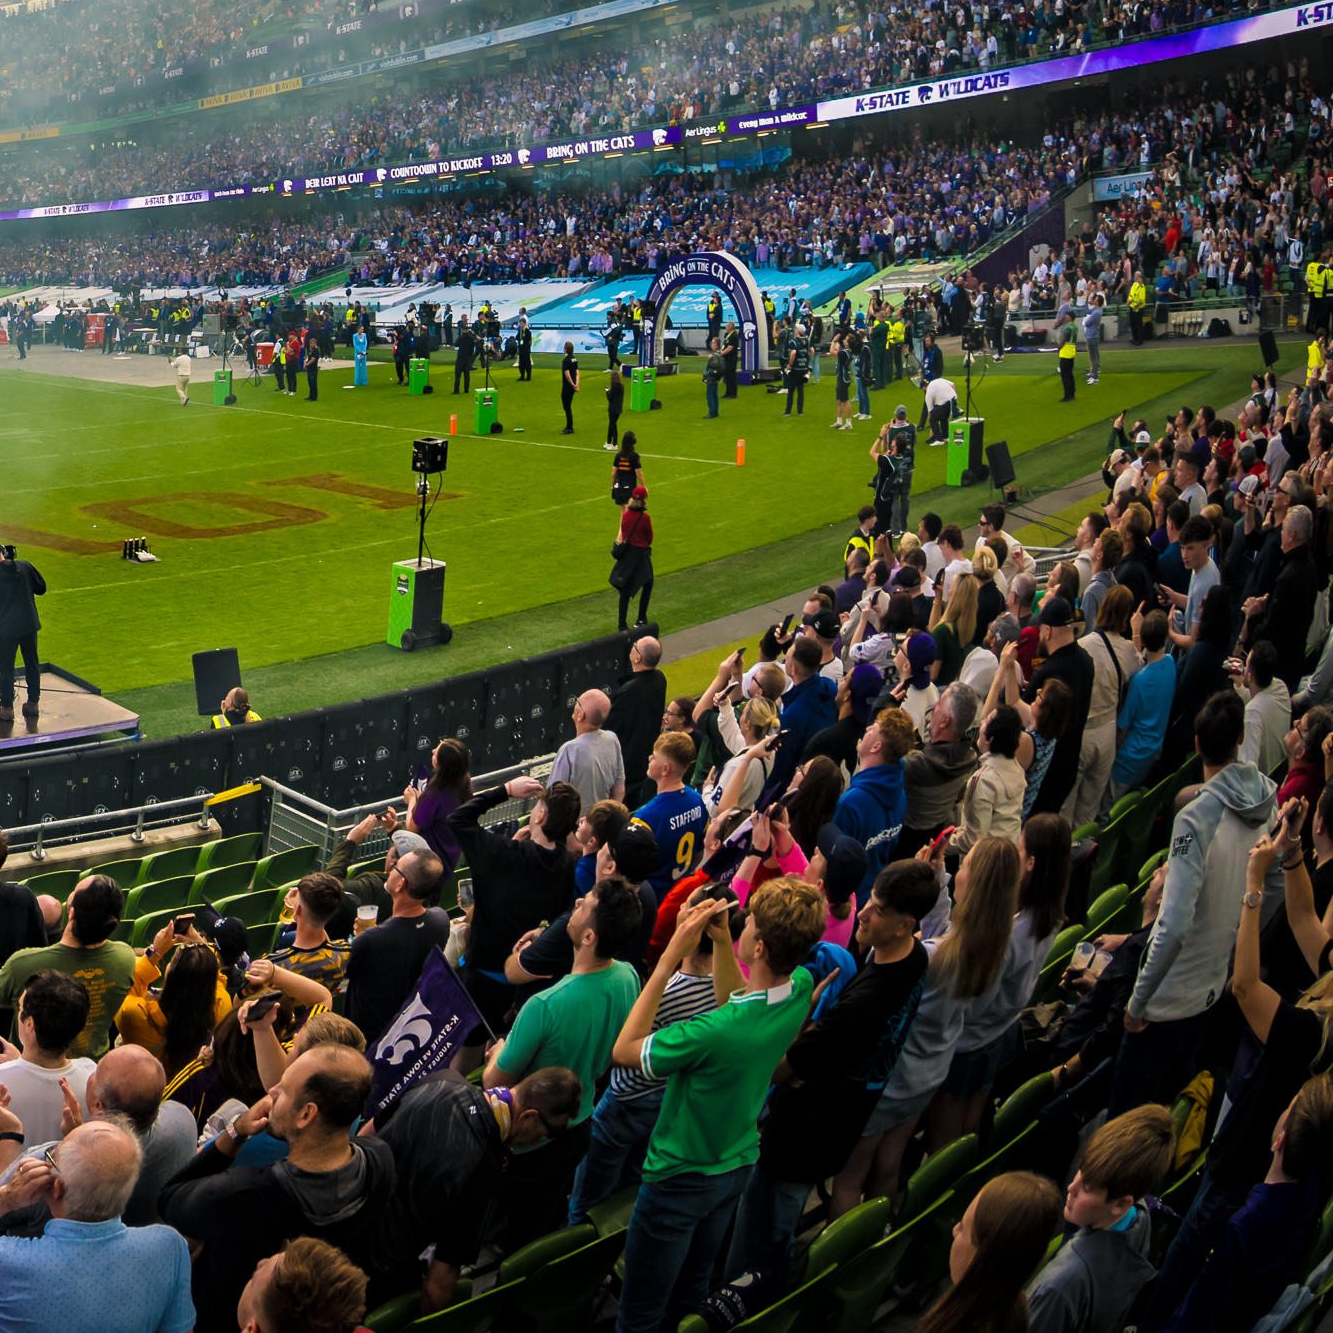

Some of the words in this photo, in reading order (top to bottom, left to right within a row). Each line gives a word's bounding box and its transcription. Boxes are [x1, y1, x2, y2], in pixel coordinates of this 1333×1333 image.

[1296, 2, 1333, 27] K-ST
[336, 20, 362, 35] K-STATE
[246, 46, 268, 58] K-STATE
[380, 54, 419, 69] visitdublin.com
[165, 67, 183, 79] K-STATE
[99, 85, 115, 95] K-STATE
[255, 85, 273, 96] AVIVA
[281, 79, 301, 91] AVIVA
[230, 90, 247, 102] AVIVA
[855, 90, 910, 114] K-STATE
[938, 71, 1010, 99] WILDCATS
[205, 96, 222, 107] AVIVA
[27, 130, 47, 139] AVIVA
[546, 144, 574, 158] BRING
[575, 141, 588, 154] ON
[590, 139, 609, 152] THE
[611, 135, 635, 150] CATS
[390, 163, 437, 179] COUNTDOWN
[438, 162, 449, 173] TO
[451, 157, 483, 172] KICKOFF
[491, 153, 512, 166] 13:20
[305, 177, 320, 189] BEIR
[320, 176, 336, 188] LEAT
[338, 174, 347, 186] NA
[348, 173, 363, 185] CAIT
[1106, 182, 1122, 194] Aer
[145, 196, 165, 205] K-STATE
[176, 192, 202, 203] WILDCATS
[44, 207, 60, 215] K-STATE
[659, 261, 685, 292] BRING
[687, 262, 696, 272] ON
[697, 262, 709, 272] THE
[712, 262, 736, 291] CATS
[669, 806, 702, 830] STAFFORD
[672, 831, 694, 880] 9
